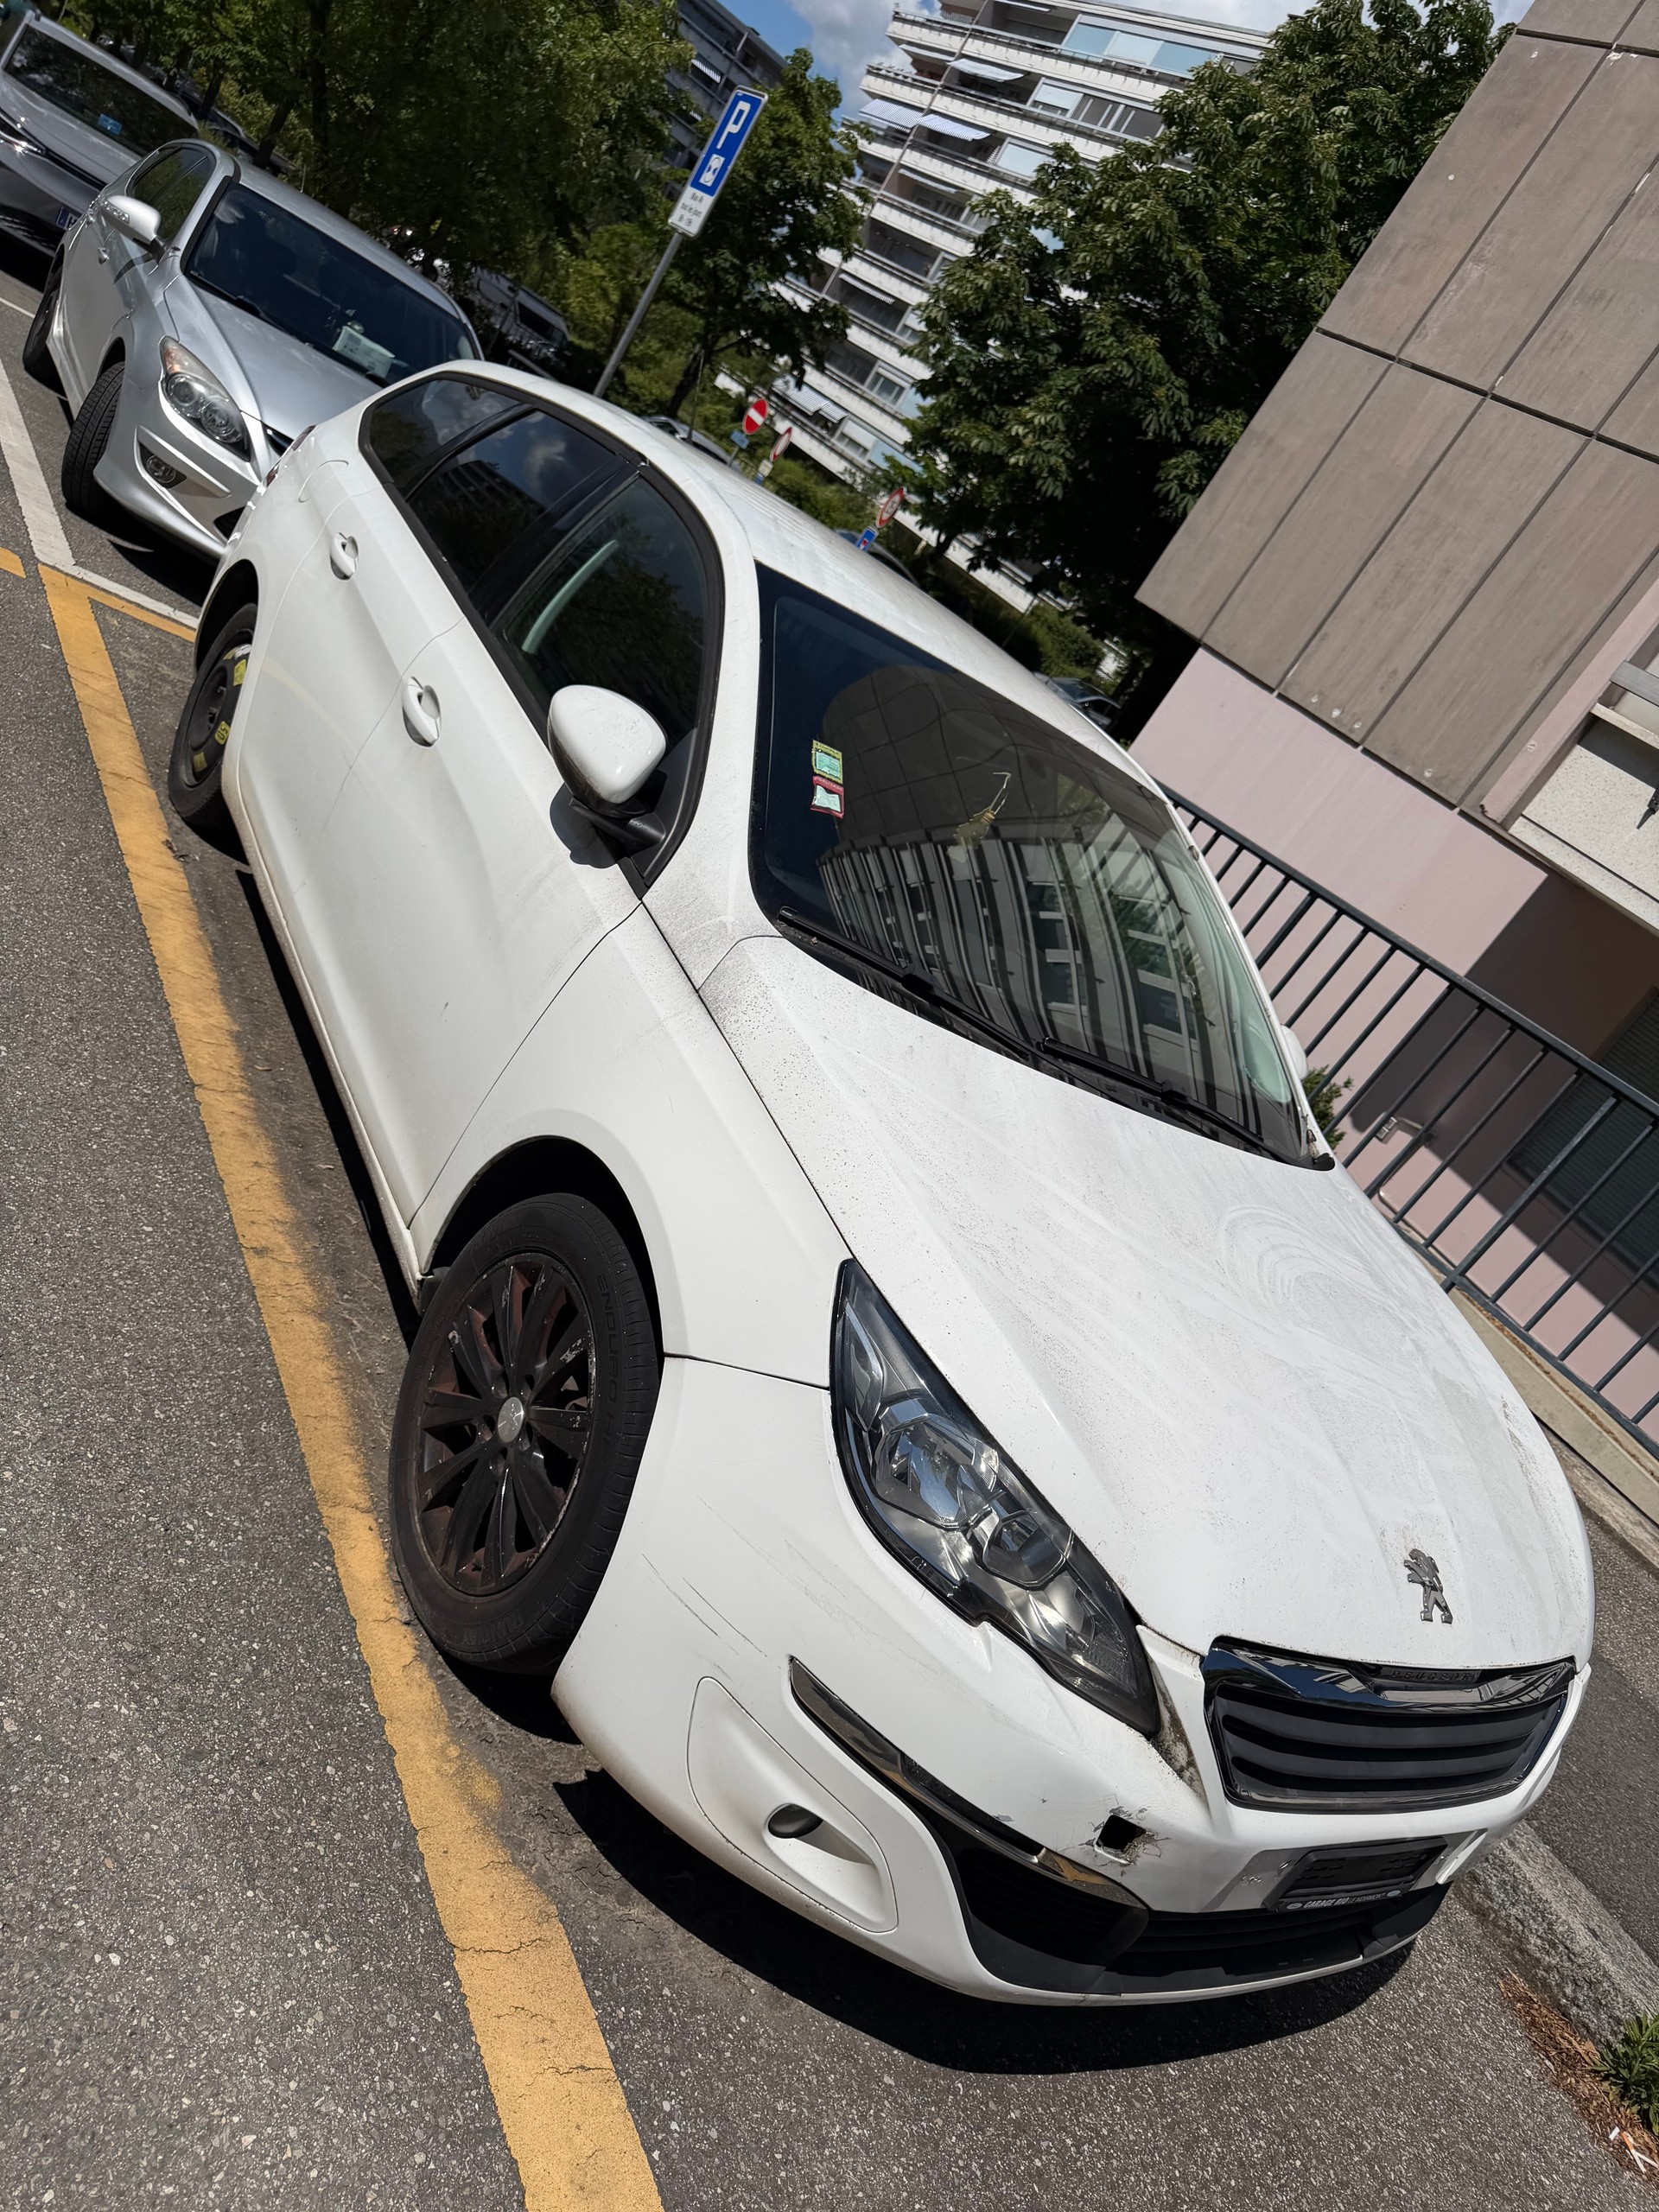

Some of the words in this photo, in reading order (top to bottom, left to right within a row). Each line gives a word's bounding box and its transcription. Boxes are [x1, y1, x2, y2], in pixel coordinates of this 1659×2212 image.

[716, 100, 751, 149] P
[595, 1274, 619, 1403] ENDURO
[1390, 1669, 1471, 1681] PEUGEOT
[1303, 1899, 1335, 1908] GARAGE
